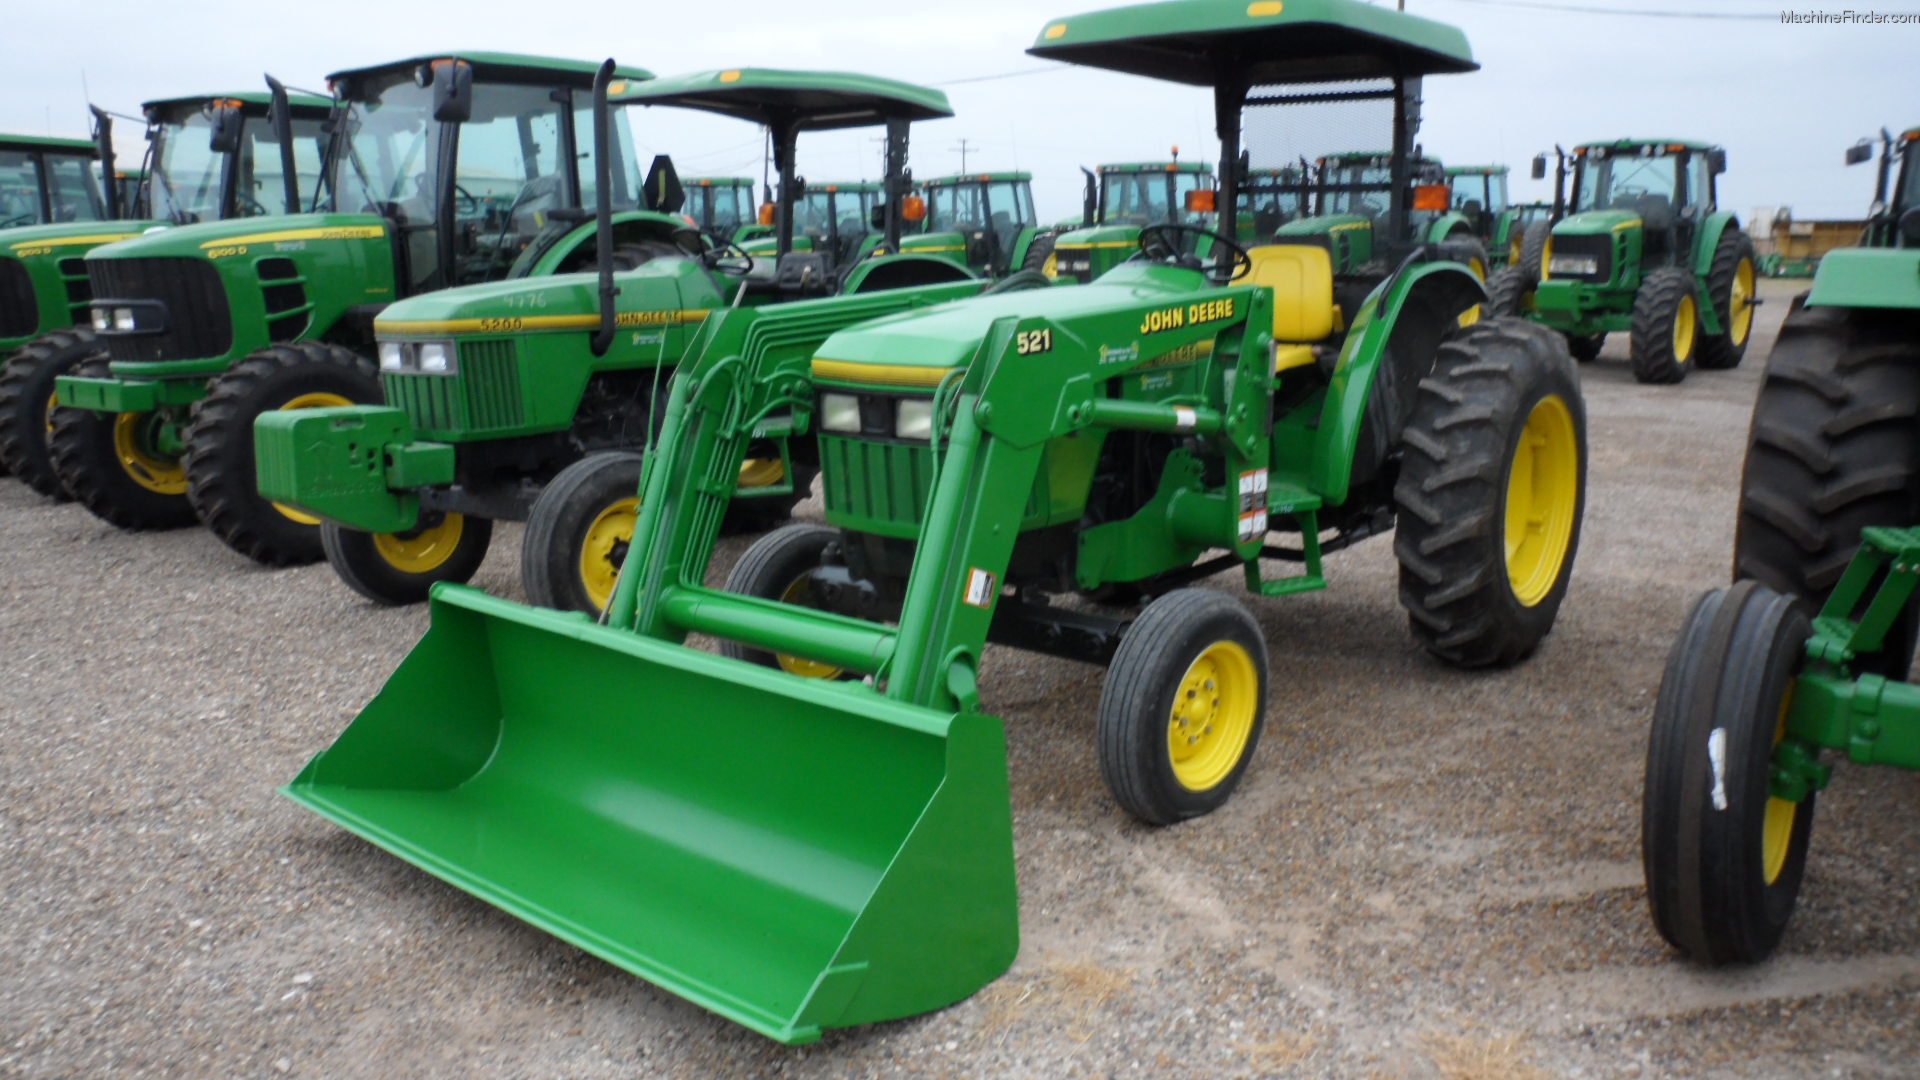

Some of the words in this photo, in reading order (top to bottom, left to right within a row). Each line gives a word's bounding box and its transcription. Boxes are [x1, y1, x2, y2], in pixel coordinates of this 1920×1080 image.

[481, 318, 522, 331] 5200
[1140, 307, 1184, 334] JOHN
[1189, 298, 1233, 325] DEERE
[1017, 328, 1052, 355] 521
